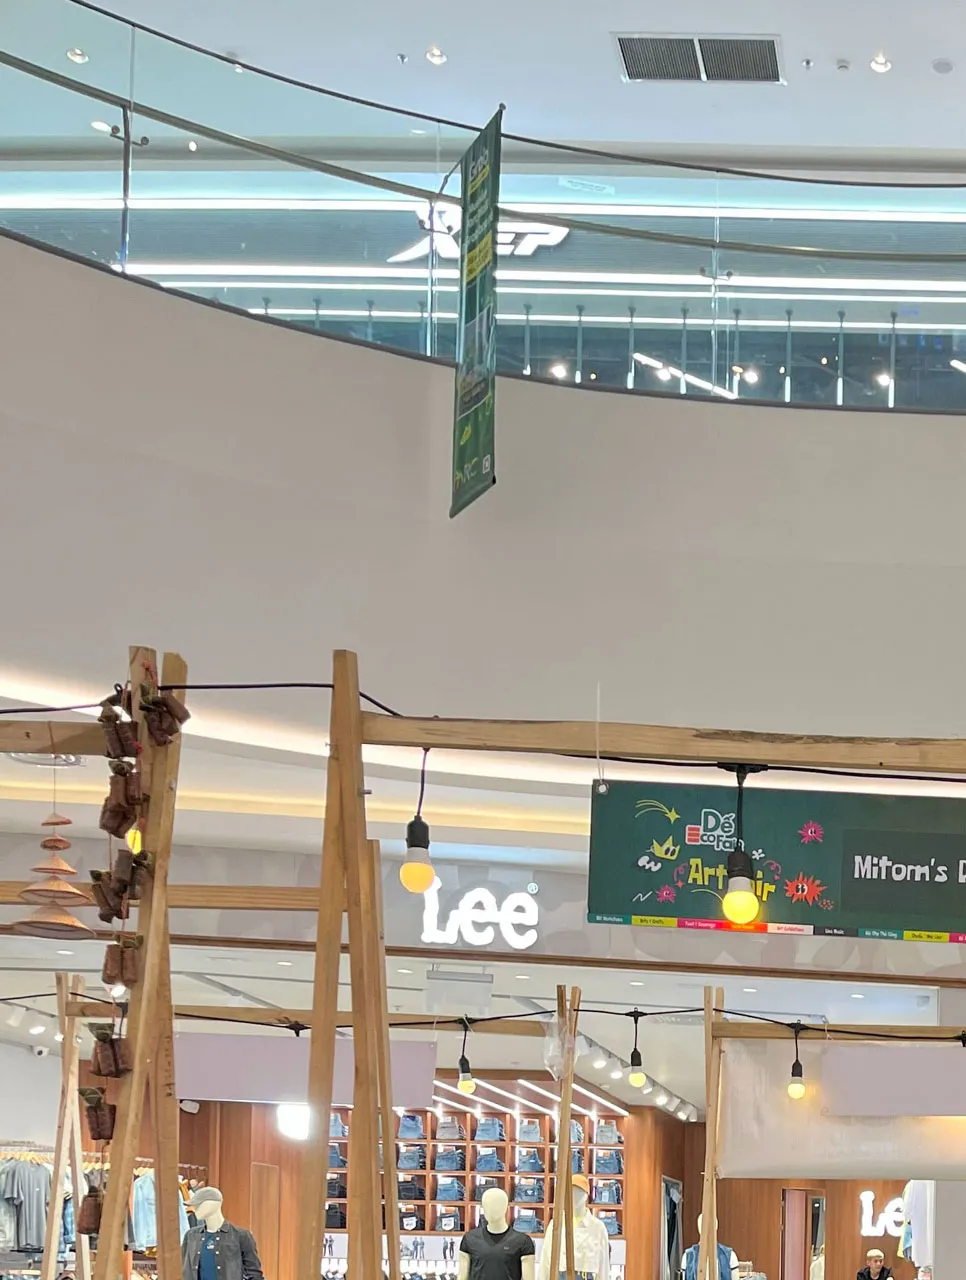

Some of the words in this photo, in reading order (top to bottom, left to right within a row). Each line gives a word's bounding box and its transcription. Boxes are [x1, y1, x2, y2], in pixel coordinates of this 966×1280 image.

[688, 858, 727, 890] Art
[853, 855, 948, 883] Mitom's
[421, 874, 539, 950] Lee
[860, 1190, 905, 1237] Le
